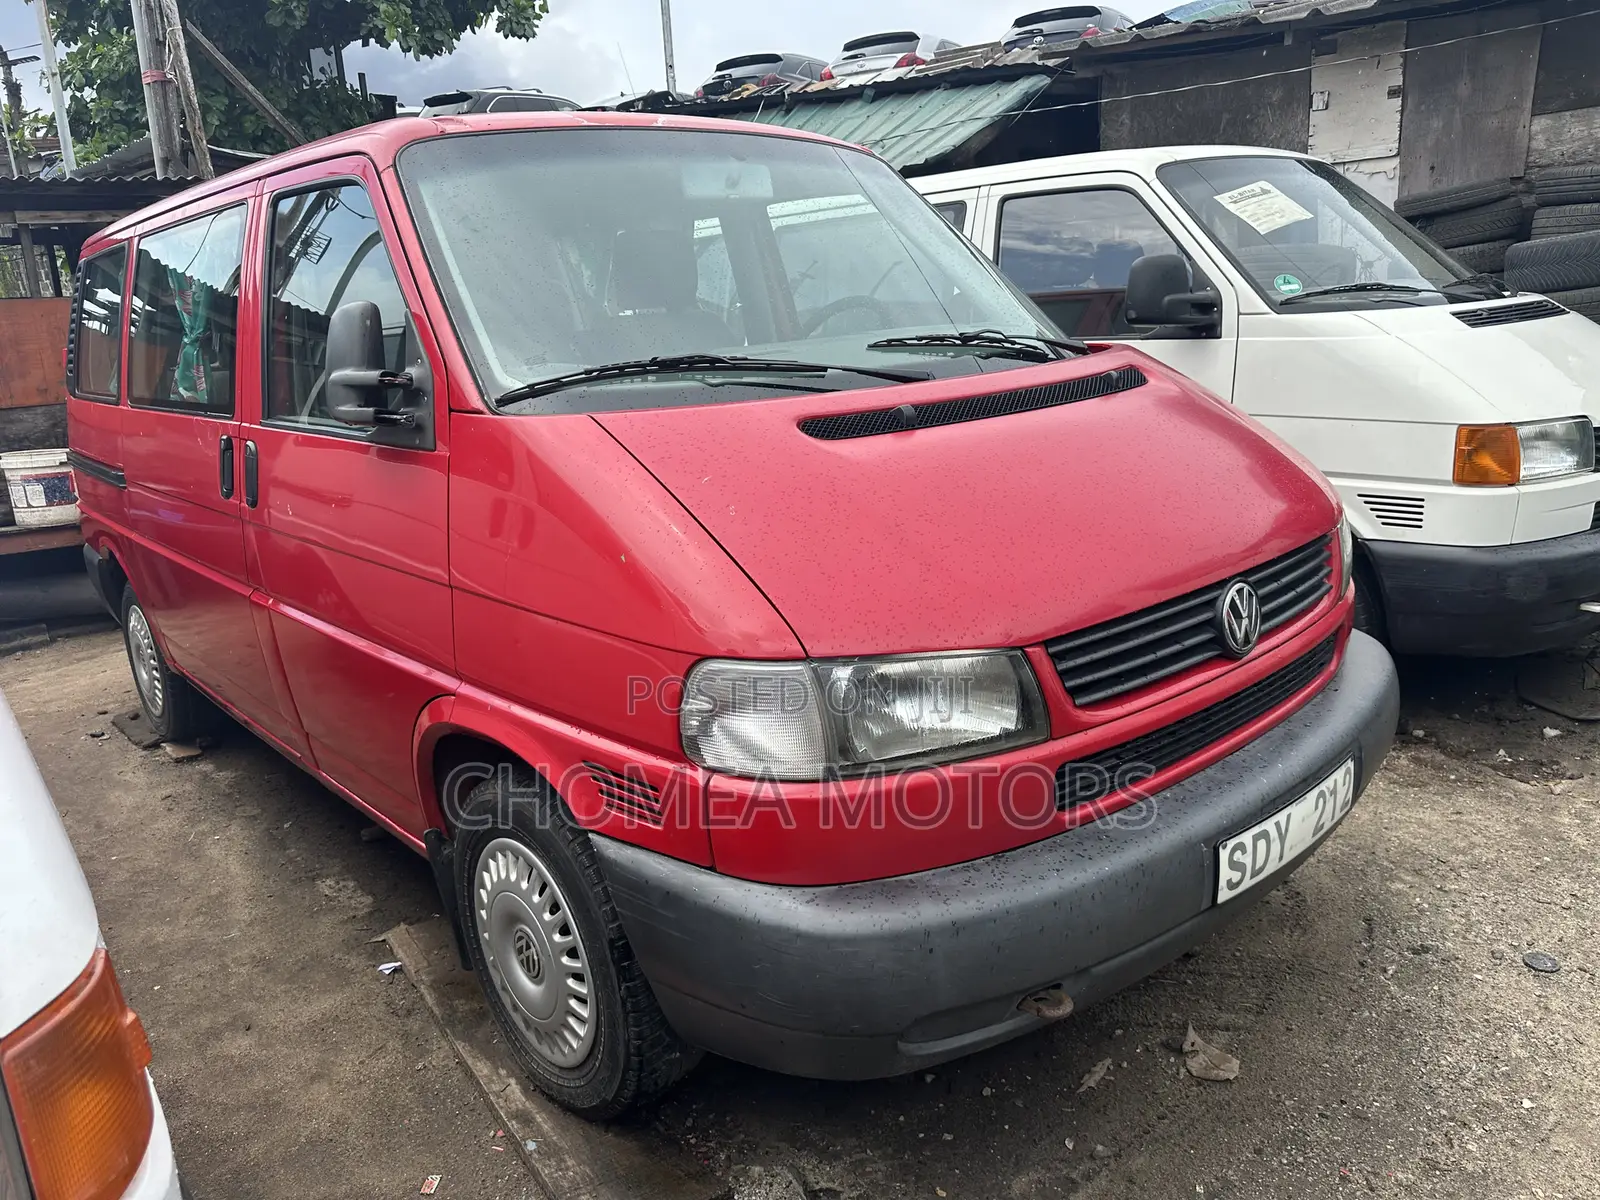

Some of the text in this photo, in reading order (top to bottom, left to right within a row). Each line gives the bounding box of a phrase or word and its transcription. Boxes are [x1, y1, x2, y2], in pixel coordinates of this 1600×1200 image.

[1283, 275, 1291, 284] 4
[1224, 582, 1260, 652] VW
[1226, 766, 1352, 892] SDY 212
